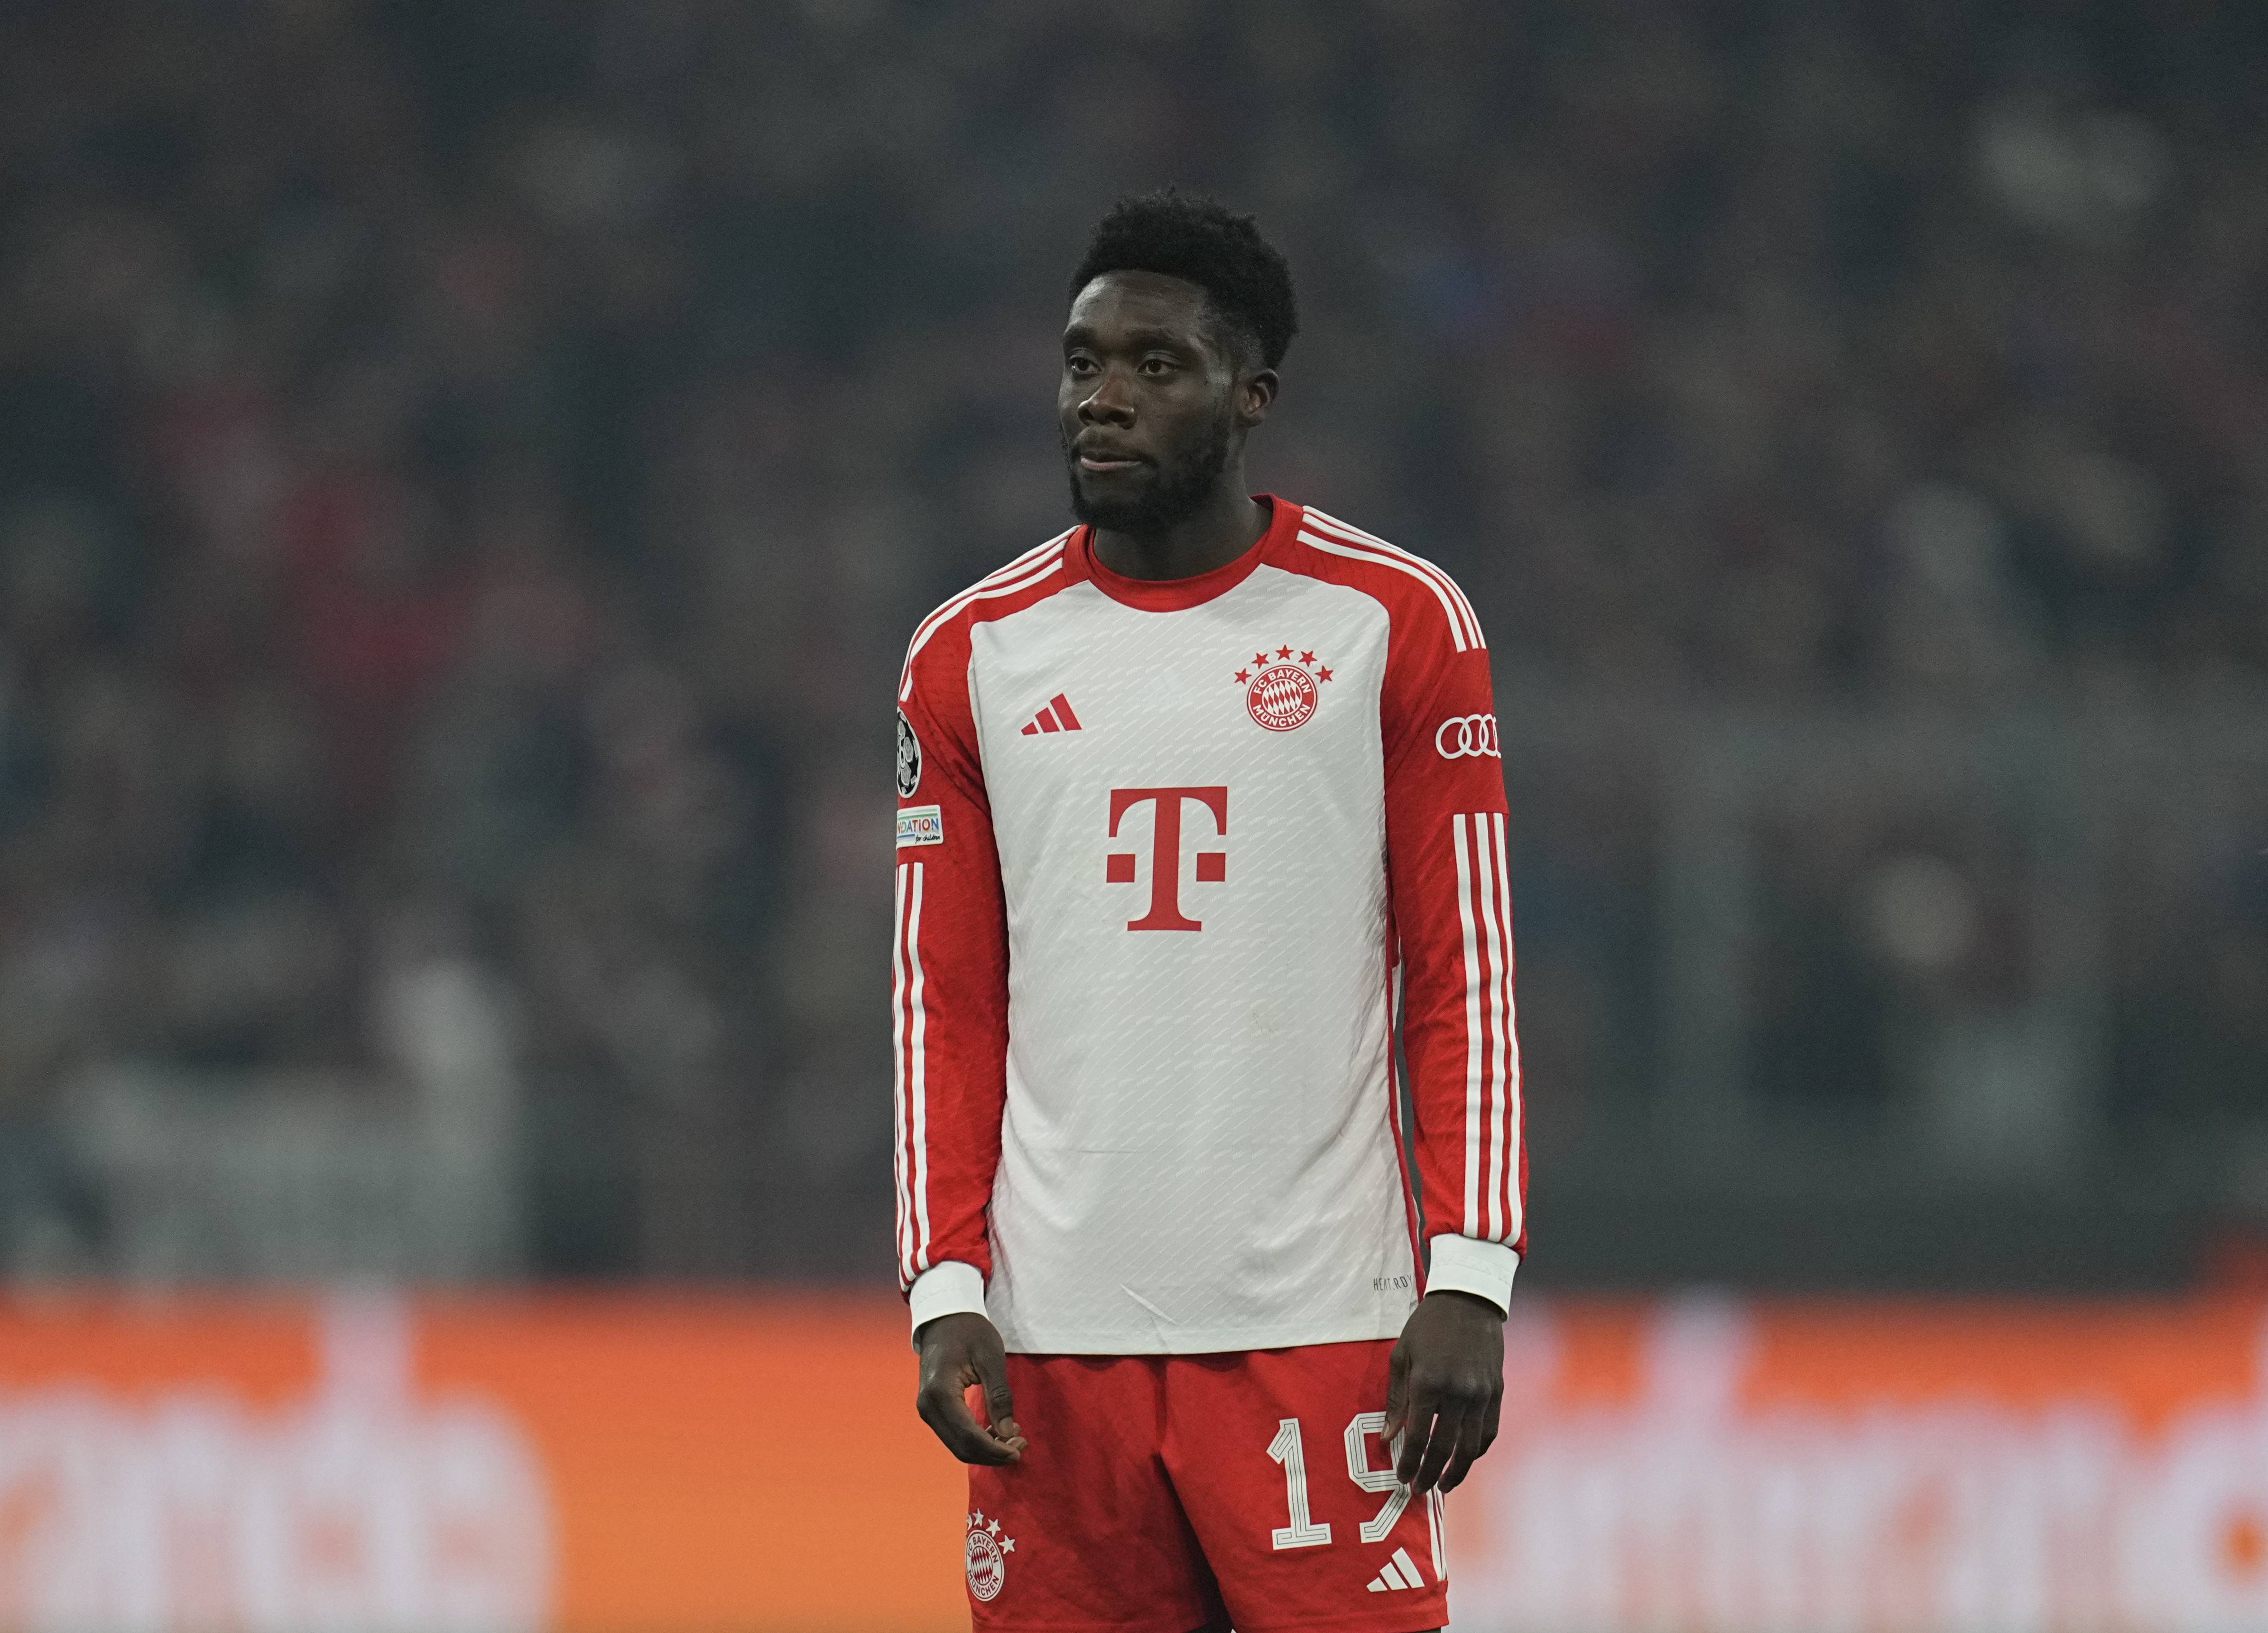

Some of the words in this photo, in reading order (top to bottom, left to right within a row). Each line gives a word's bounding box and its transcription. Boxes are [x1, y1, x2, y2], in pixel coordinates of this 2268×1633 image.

[1253, 679, 1267, 694] FC
[1268, 669, 1312, 693] BAYERN
[1253, 704, 1311, 727] MÜNCHEN
[1109, 786, 1227, 931] T
[1373, 1274, 1413, 1291] HEAT.RDY
[1266, 1411, 1412, 1550] 19
[967, 1543, 972, 1557] FC
[972, 1535, 999, 1563] BAYERN
